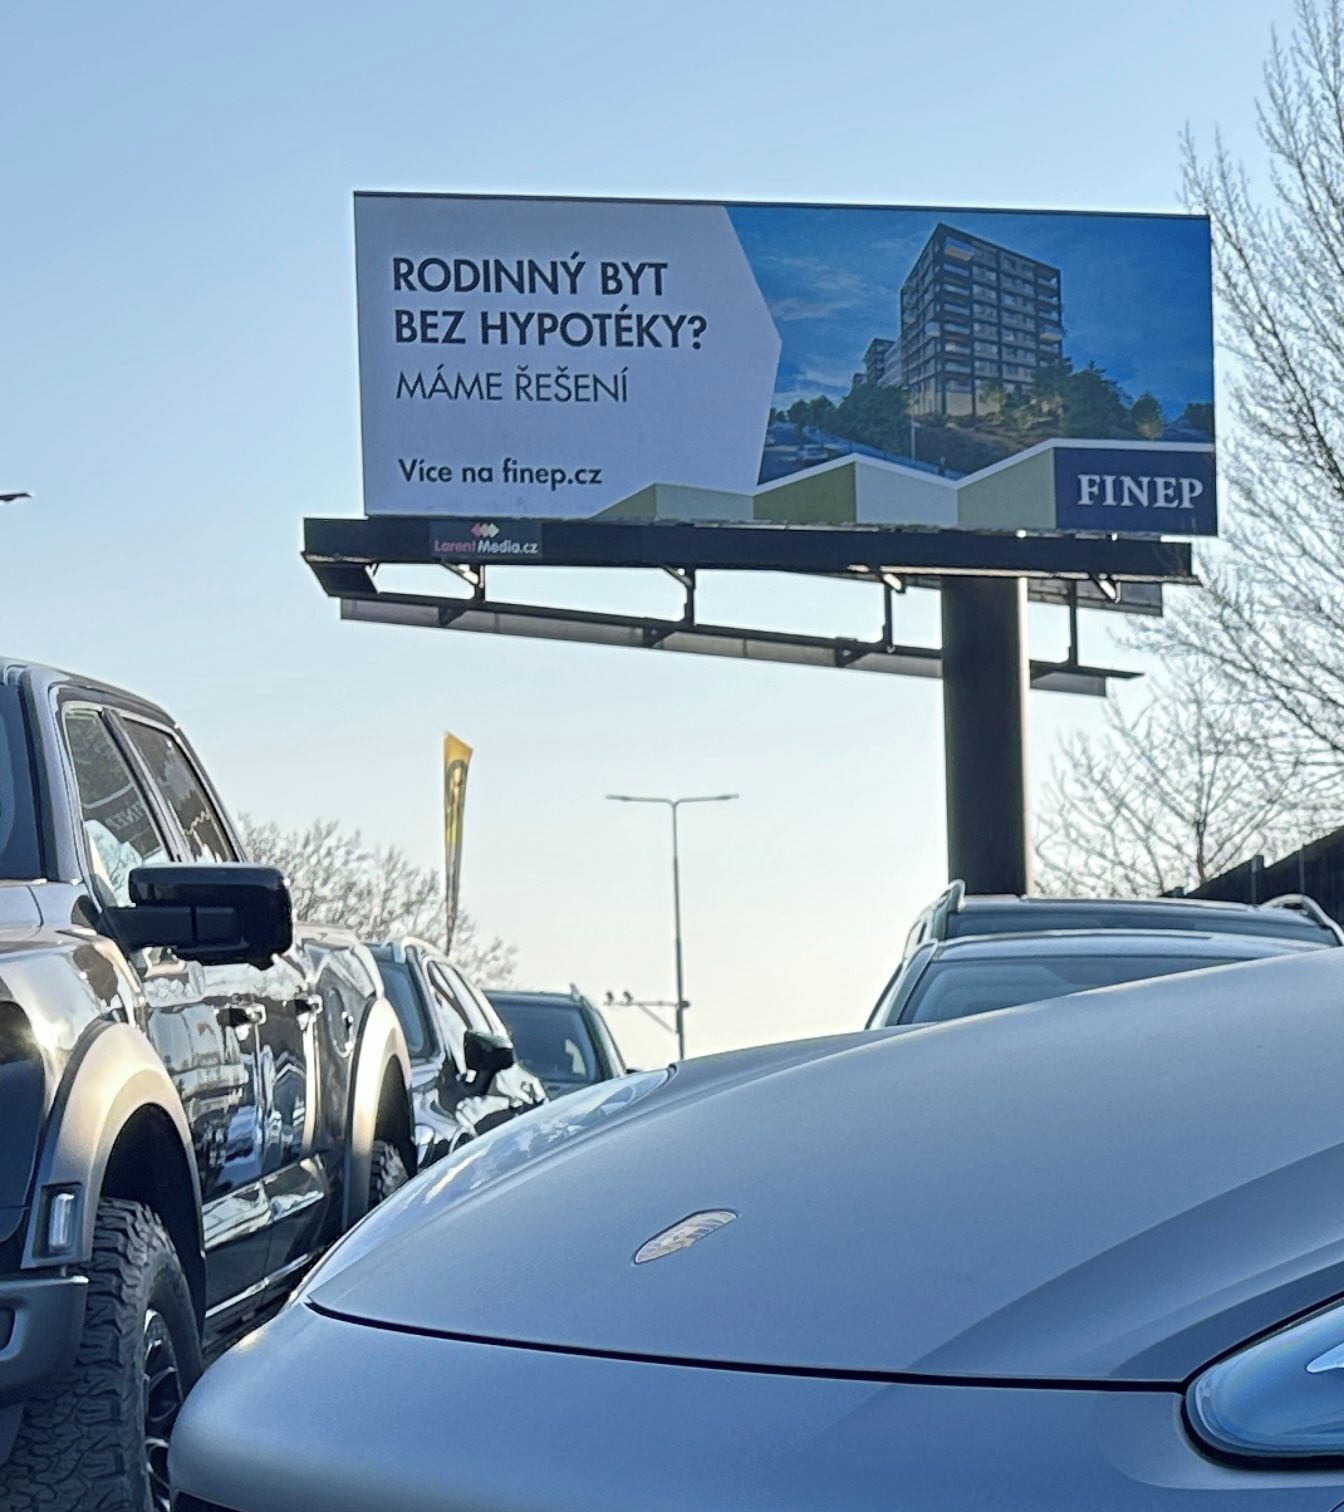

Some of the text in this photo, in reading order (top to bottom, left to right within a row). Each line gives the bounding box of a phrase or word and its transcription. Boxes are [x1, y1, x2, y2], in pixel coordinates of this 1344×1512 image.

[393, 251, 668, 296] RODINNÝ BYT
[394, 303, 707, 350] BEZ HYPOTÉKY?
[396, 364, 629, 402] MÁME ŘEŠENÍ
[398, 457, 603, 491] Více na finep.cz
[1077, 474, 1204, 509] FINEP
